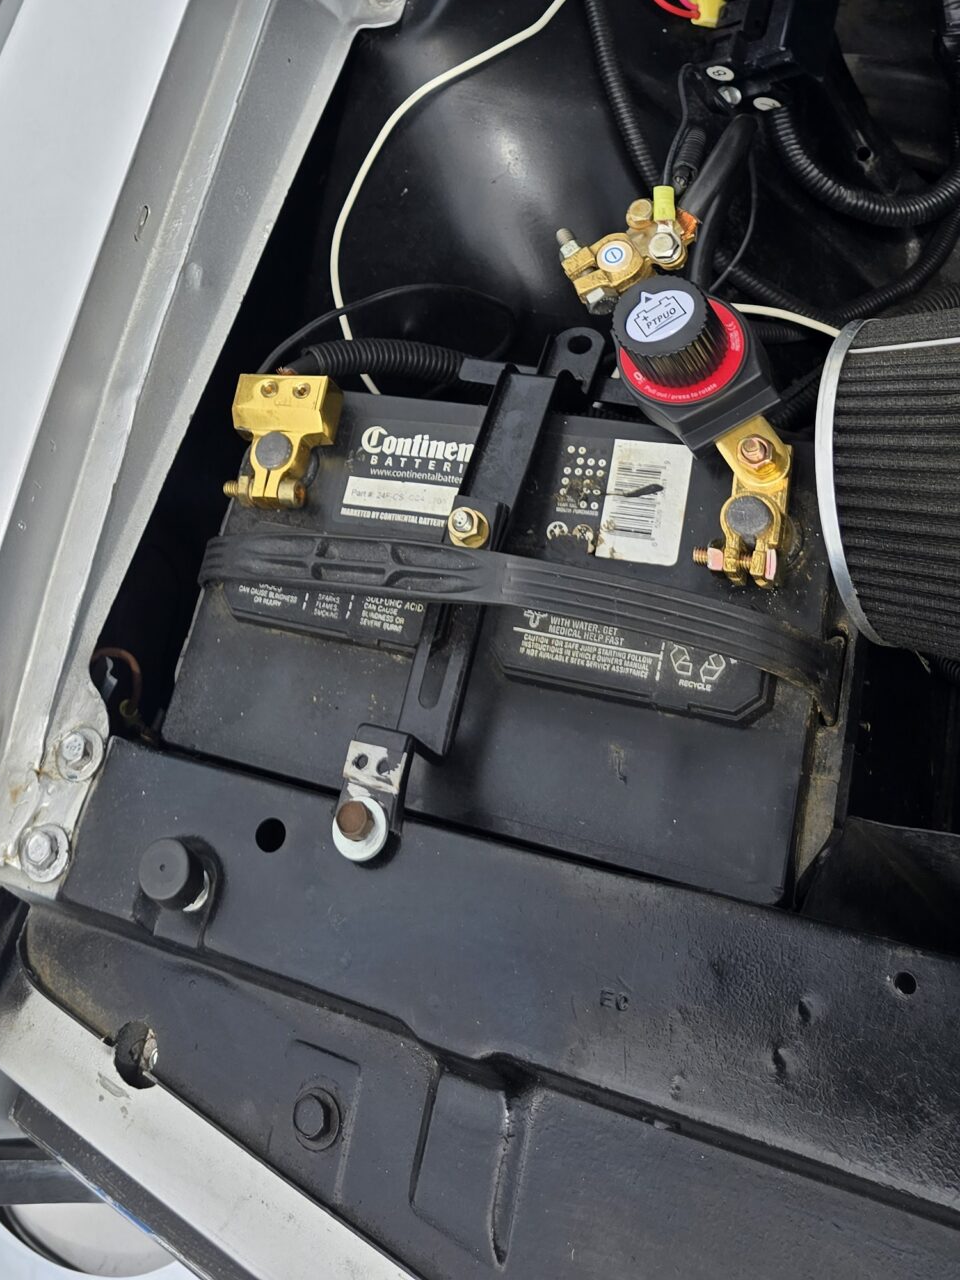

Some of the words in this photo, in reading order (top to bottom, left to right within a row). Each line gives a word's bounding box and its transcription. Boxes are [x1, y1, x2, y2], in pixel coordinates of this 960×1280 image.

[646, 307, 677, 329] PTPUO
[699, 383, 717, 395] rotate
[370, 455, 464, 474] BATTERI
[351, 488, 367, 497] Part
[250, 587, 268, 598] CAUSE
[361, 609, 394, 623] BLINDNESS
[394, 616, 405, 625] OR
[364, 602, 377, 611] CAN
[377, 605, 398, 616] CAUSE
[548, 624, 581, 639] MEDICAL
[583, 631, 604, 643] HELP
[605, 636, 625, 646] FAST
[550, 615, 571, 627] WITH
[602, 625, 619, 636] GET
[521, 640, 563, 654] INSTRUCTIONS
[571, 650, 596, 661] VEHICLE
[623, 659, 649, 671] MANUAL
[564, 641, 579, 650] SAFE
[580, 644, 597, 653] JUMP
[597, 647, 627, 659] STARTING
[627, 653, 653, 665] FOLLOW
[526, 647, 539, 657] NOT
[539, 651, 569, 663] AVAILABLE
[585, 659, 611, 671] SERVICE
[611, 664, 648, 679] ASSISTANCE
[679, 679, 712, 692] RECYCLE
